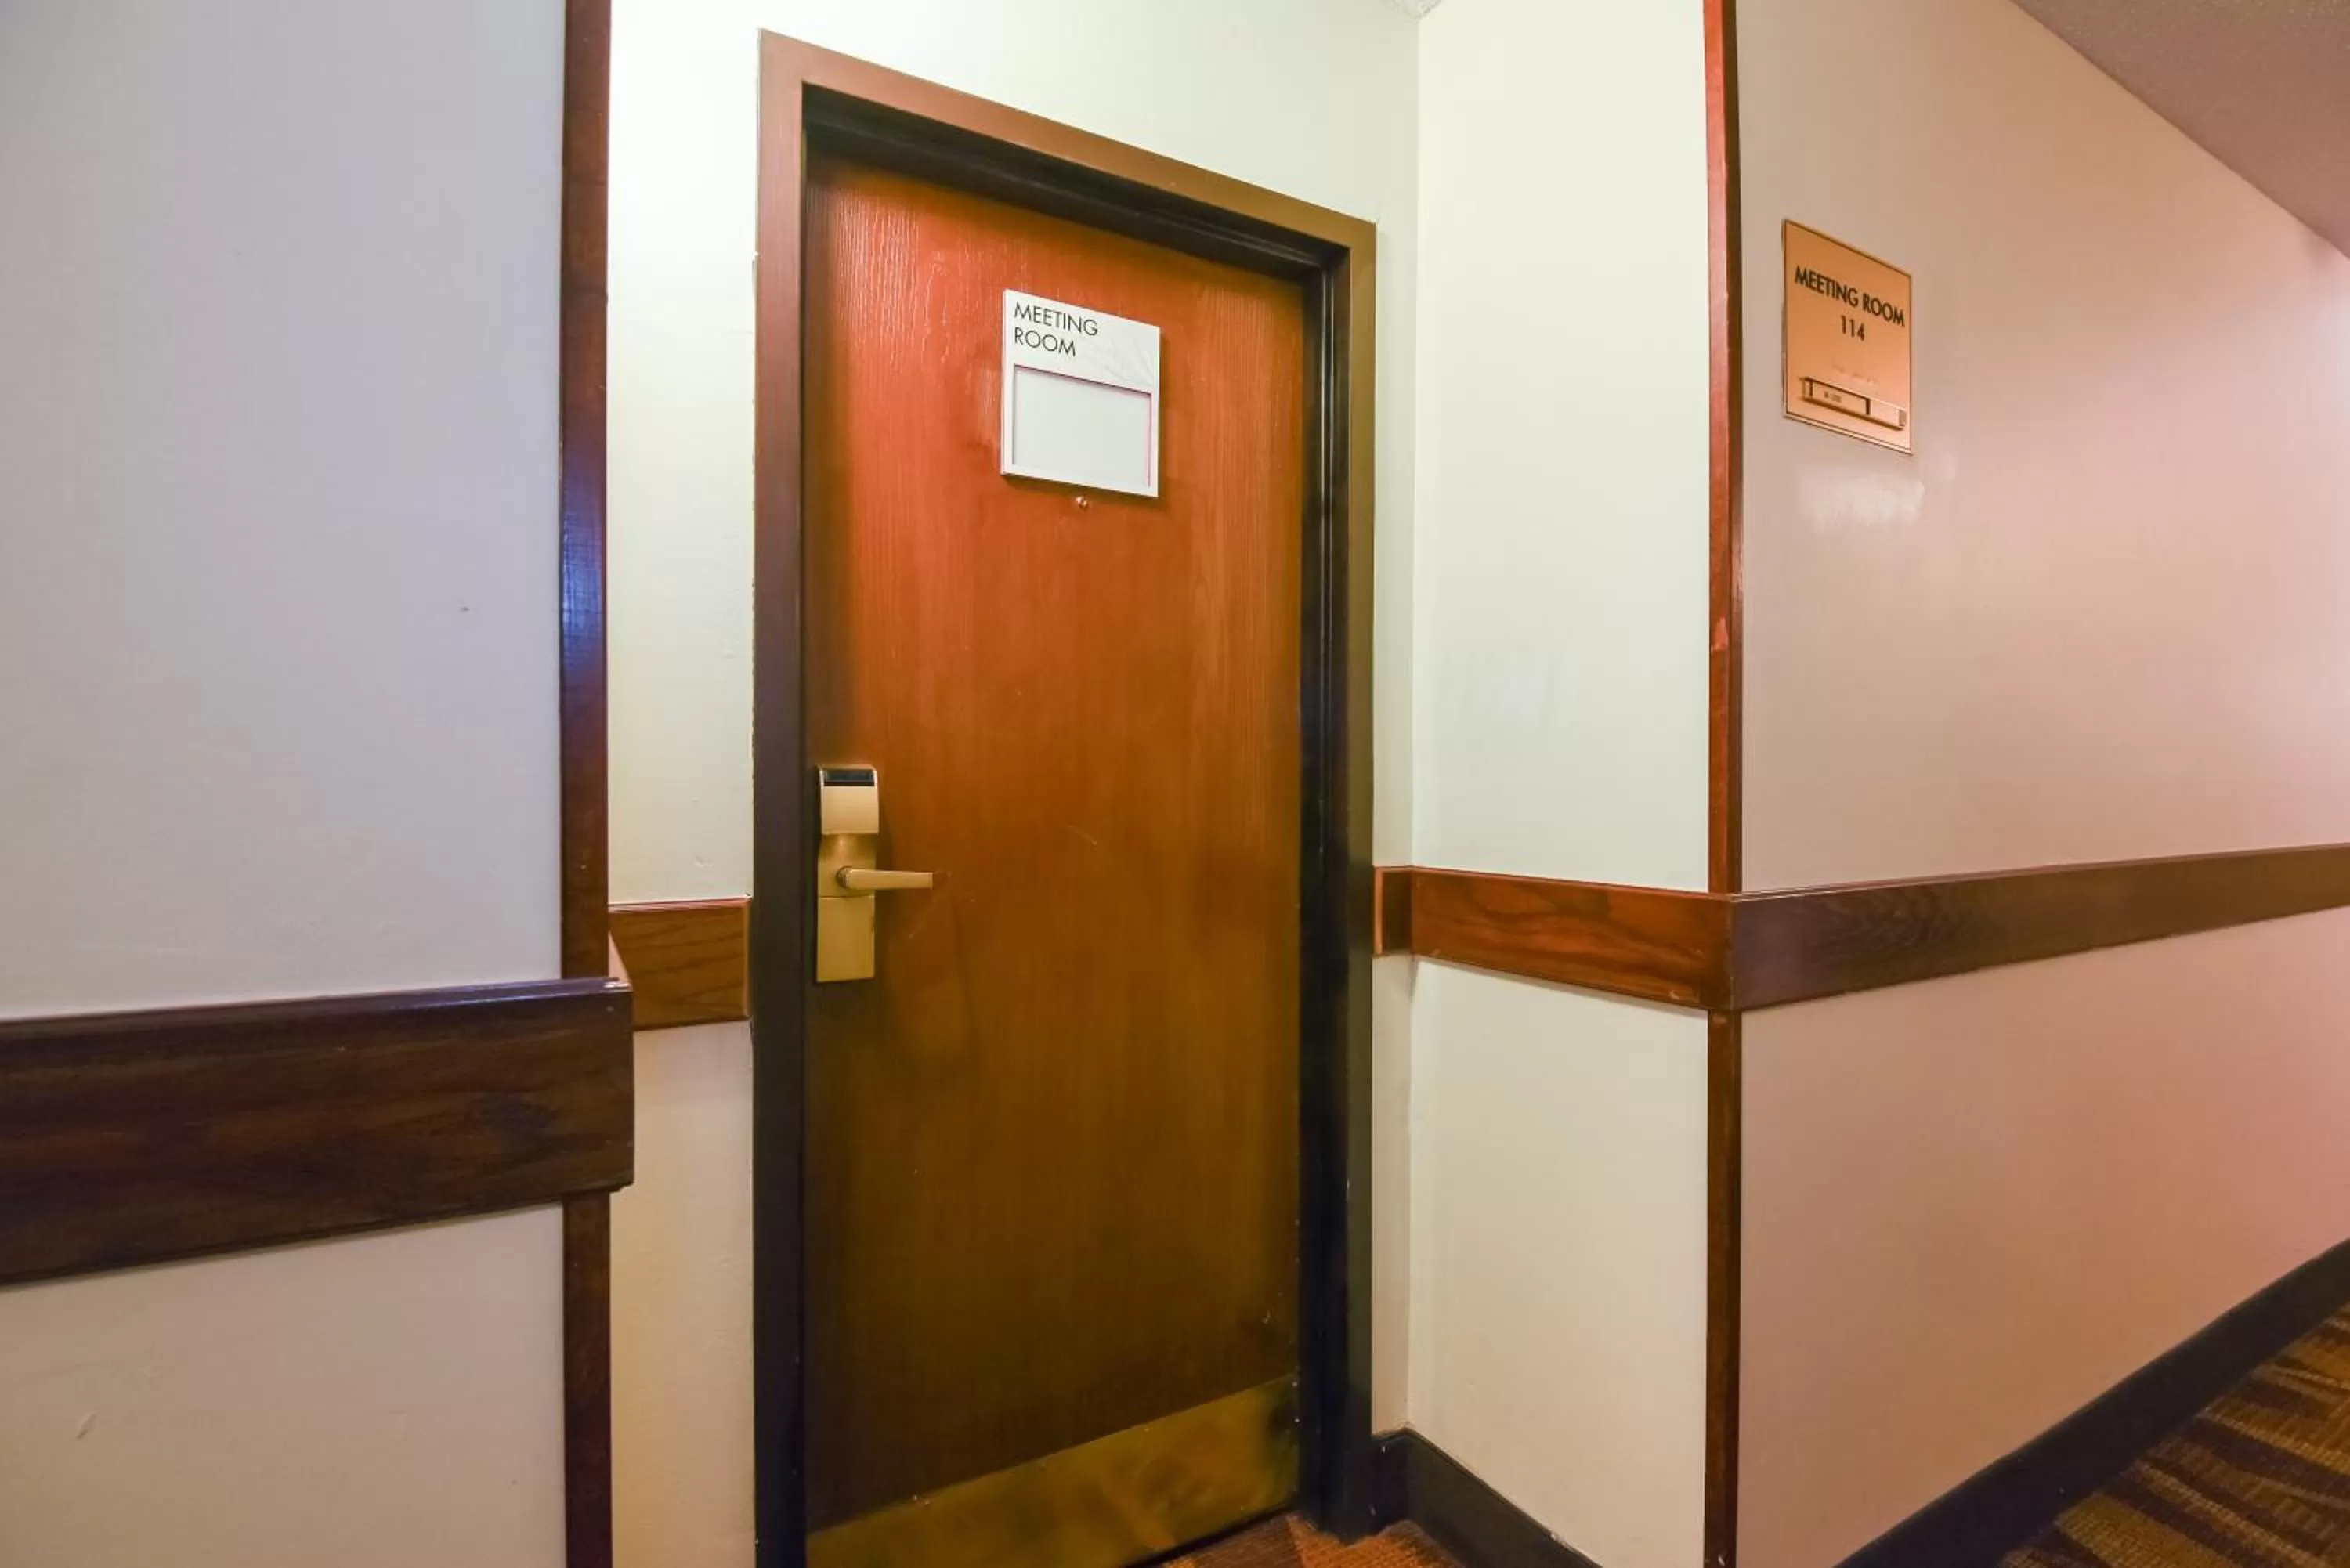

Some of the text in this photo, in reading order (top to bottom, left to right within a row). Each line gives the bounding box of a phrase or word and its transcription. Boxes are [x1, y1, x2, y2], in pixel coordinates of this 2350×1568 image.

[1795, 266, 1905, 327] MEETING ROOM
[1014, 302, 1098, 336] MEETING
[1841, 315, 1865, 341] 114
[1014, 327, 1076, 356] ROOM
